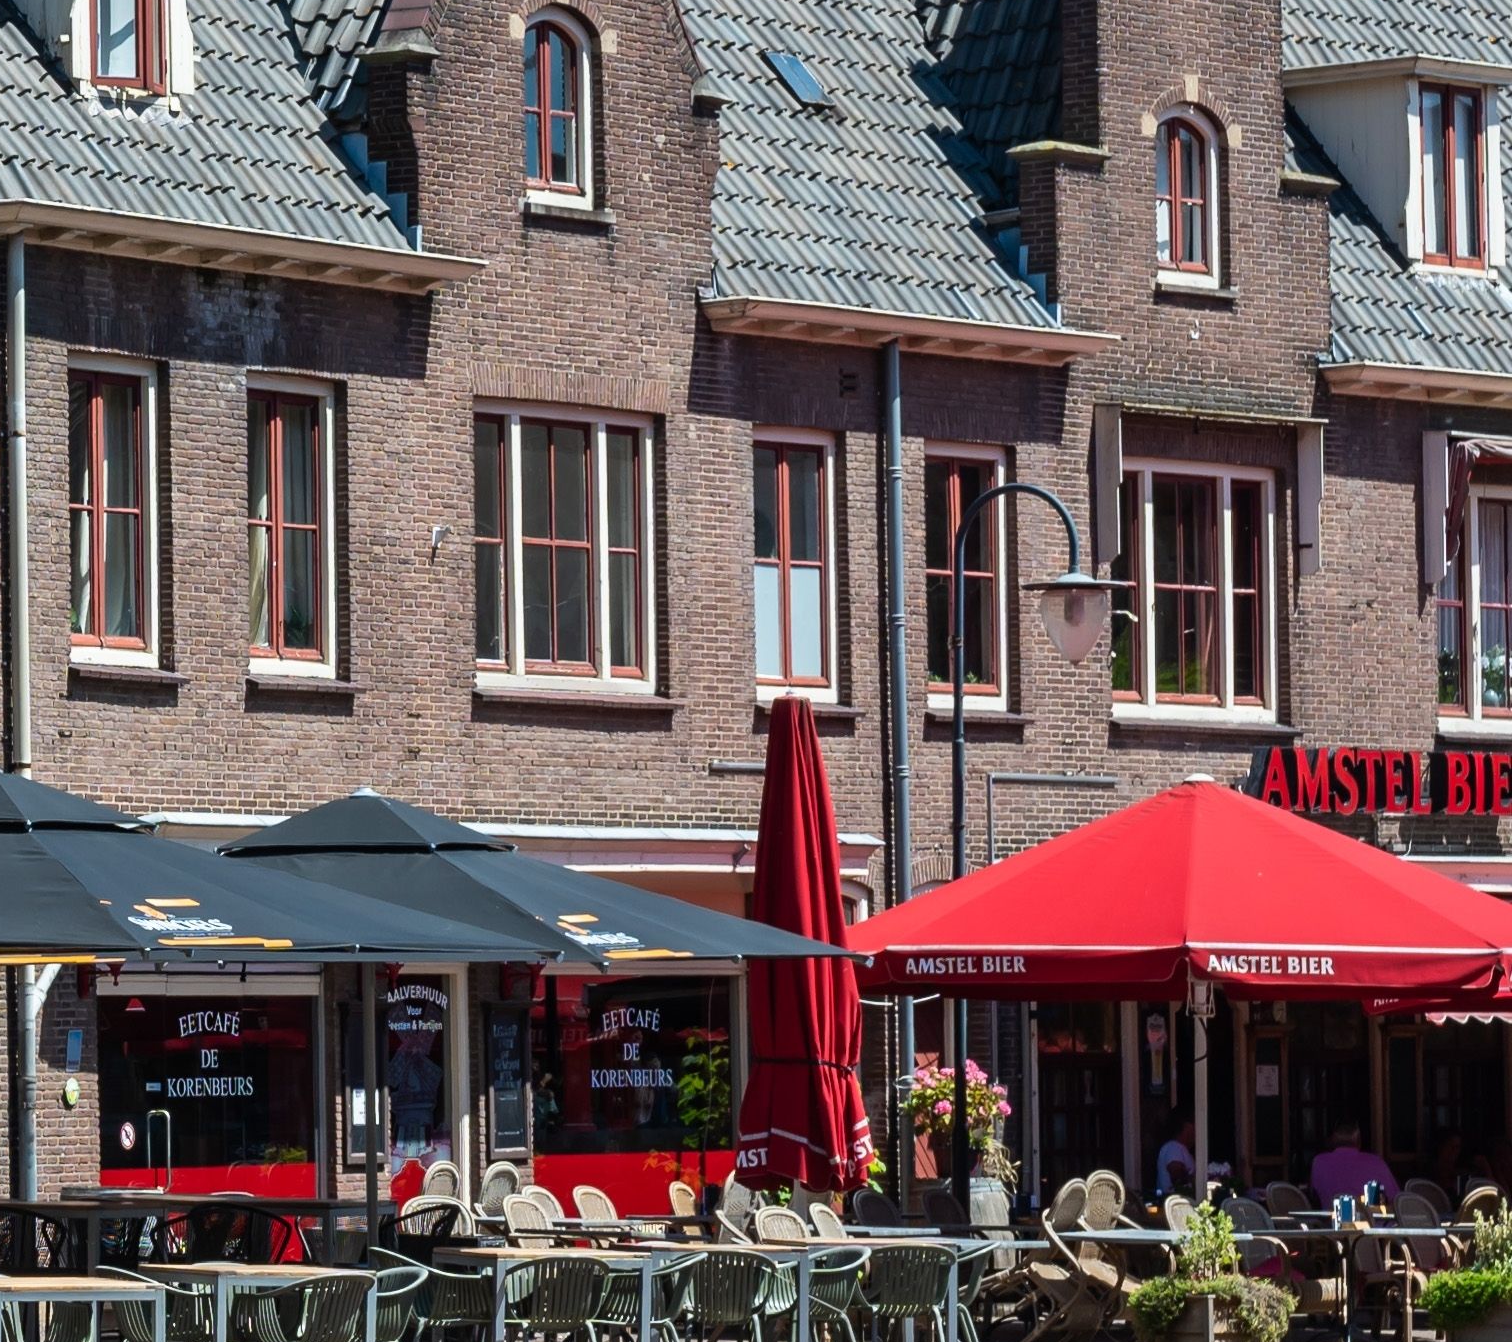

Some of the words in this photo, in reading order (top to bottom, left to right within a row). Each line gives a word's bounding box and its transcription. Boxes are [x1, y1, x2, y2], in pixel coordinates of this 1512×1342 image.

[1263, 746, 1432, 816] AMSTEL
[1443, 750, 1512, 816] BIE
[905, 957, 978, 975] AMSTEL
[982, 956, 1026, 973] BIER
[1207, 954, 1282, 974] AMSTEL
[1287, 956, 1335, 975] BIER
[387, 984, 448, 1010] AALVERHUUR
[178, 1011, 241, 1037] EETCAFÉ
[602, 1008, 661, 1032] EETCAFÉ
[201, 1049, 219, 1068] DE
[623, 1042, 641, 1061] DE
[167, 1076, 254, 1097] KORENBEURS
[591, 1068, 674, 1088] KORENBEURS
